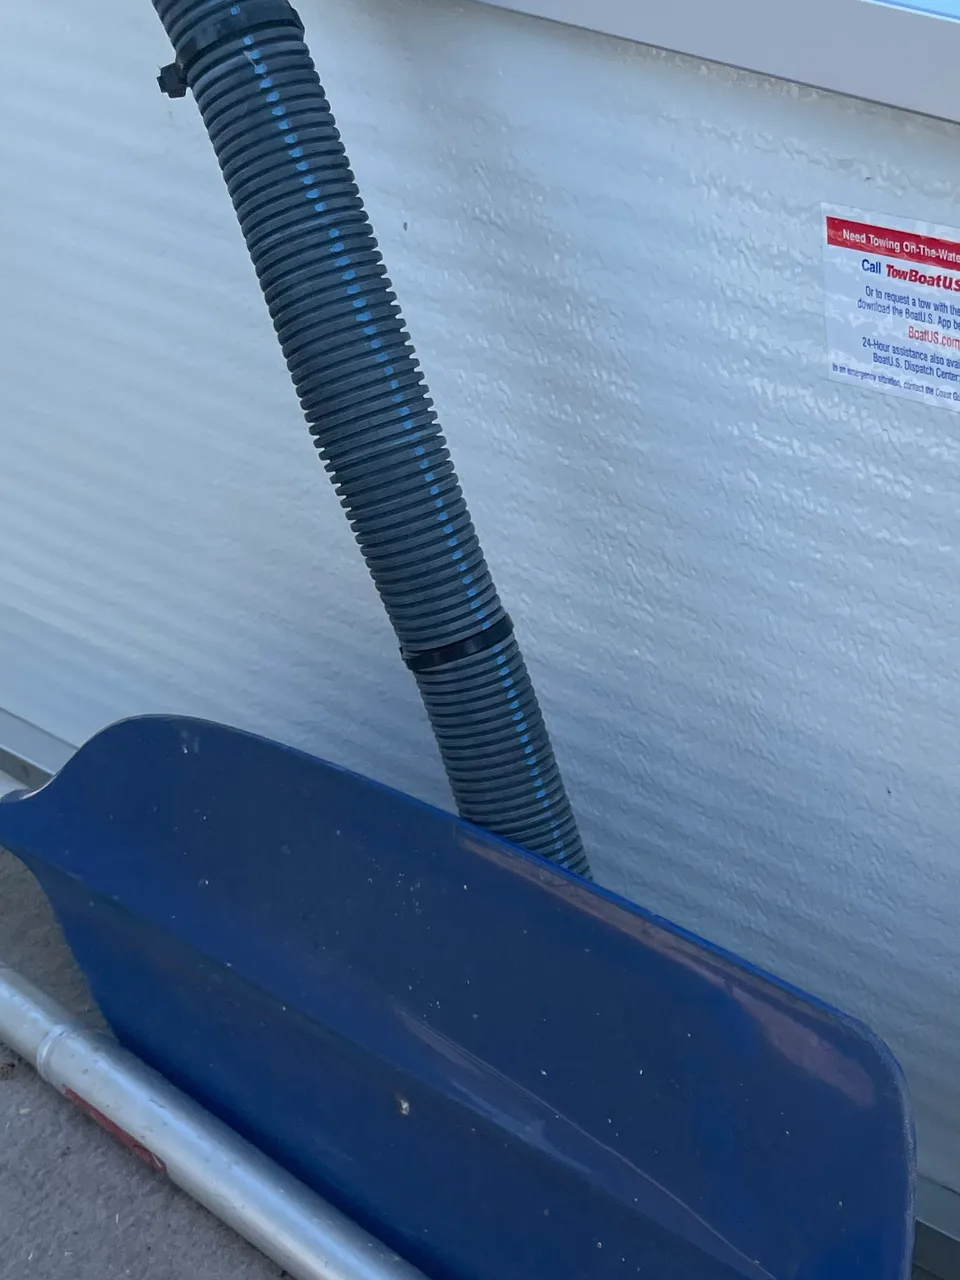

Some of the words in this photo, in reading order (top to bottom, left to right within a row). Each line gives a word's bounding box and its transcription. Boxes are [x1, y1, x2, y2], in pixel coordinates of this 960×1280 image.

[843, 229, 866, 243] Need
[869, 234, 900, 252] Towing
[862, 259, 881, 274] Call
[857, 298, 891, 315] download
[892, 305, 903, 317] the
[905, 308, 935, 324] BoatU.S.
[938, 316, 952, 330] App
[865, 286, 874, 297] Or
[875, 288, 882, 299] to
[884, 291, 910, 306] request
[912, 298, 917, 307] a
[918, 297, 931, 309] tow
[933, 302, 948, 314] with
[950, 304, 960, 316] the
[862, 337, 890, 353] 24-Hour
[892, 345, 928, 362] assistance
[930, 353, 945, 366] also
[873, 352, 903, 369] BoatU.S.
[904, 359, 934, 377] Dispatch
[936, 367, 960, 383] Center:
[847, 368, 877, 381] emergency
[904, 381, 924, 393] contact
[925, 386, 934, 395] the
[935, 389, 952, 399] Coast
